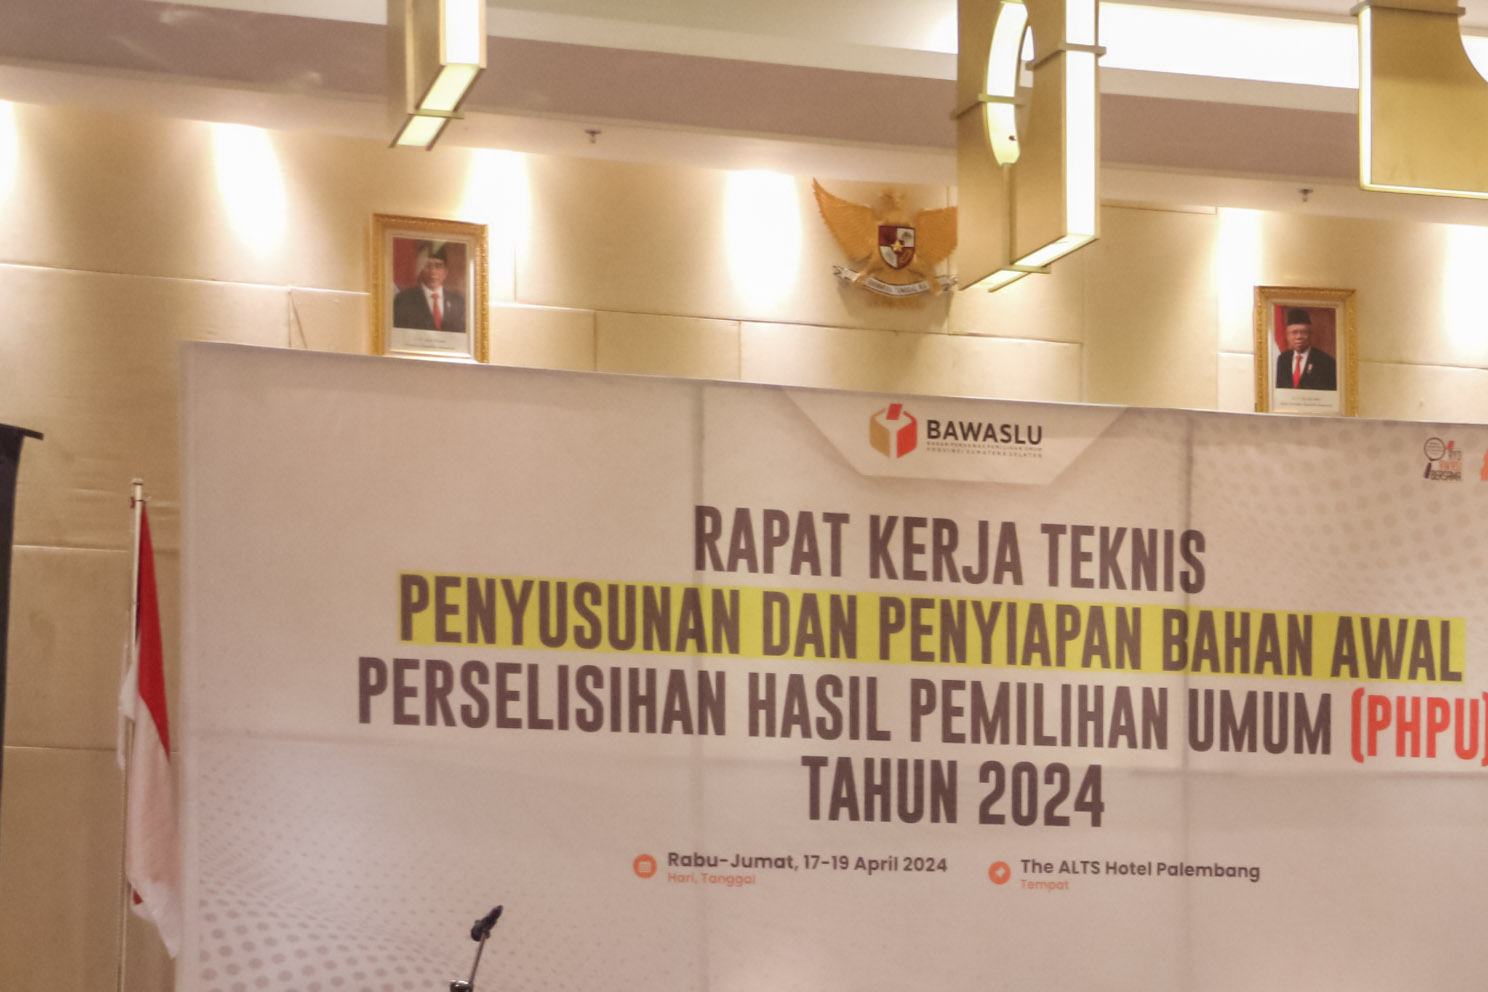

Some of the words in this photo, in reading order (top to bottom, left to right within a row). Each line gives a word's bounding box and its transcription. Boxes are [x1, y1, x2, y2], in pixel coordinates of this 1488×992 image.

[927, 420, 1042, 445] BAWASLU
[695, 505, 849, 576] RAPAT
[870, 515, 1022, 586] KERJA
[1041, 524, 1205, 594] TEKNIS
[400, 573, 739, 654] PENYUSUNAN
[763, 591, 857, 658] DAN
[880, 597, 1142, 671] PENYIAPAN
[1162, 608, 1313, 677] BAHAN
[1331, 615, 1462, 681] AWAL
[358, 657, 726, 736] PERSELISIHAN
[748, 672, 890, 741] HASIL
[910, 679, 1167, 750] PEMILIHAN
[1188, 690, 1332, 755] UMUM
[802, 756, 957, 823] TAHUN
[978, 760, 1104, 828] 2024
[668, 850, 799, 872] Rabu-Jumat,
[803, 853, 850, 870] 17-19
[855, 854, 897, 875] April
[903, 857, 947, 873] 2024
[1021, 859, 1053, 875] The
[1058, 860, 1099, 875] ALTS
[1105, 861, 1150, 877] Hotel
[1156, 863, 1260, 882] Palembang
[668, 871, 698, 886] Hari,
[702, 872, 756, 888] Tanggal
[1020, 878, 1069, 891] Tempat
